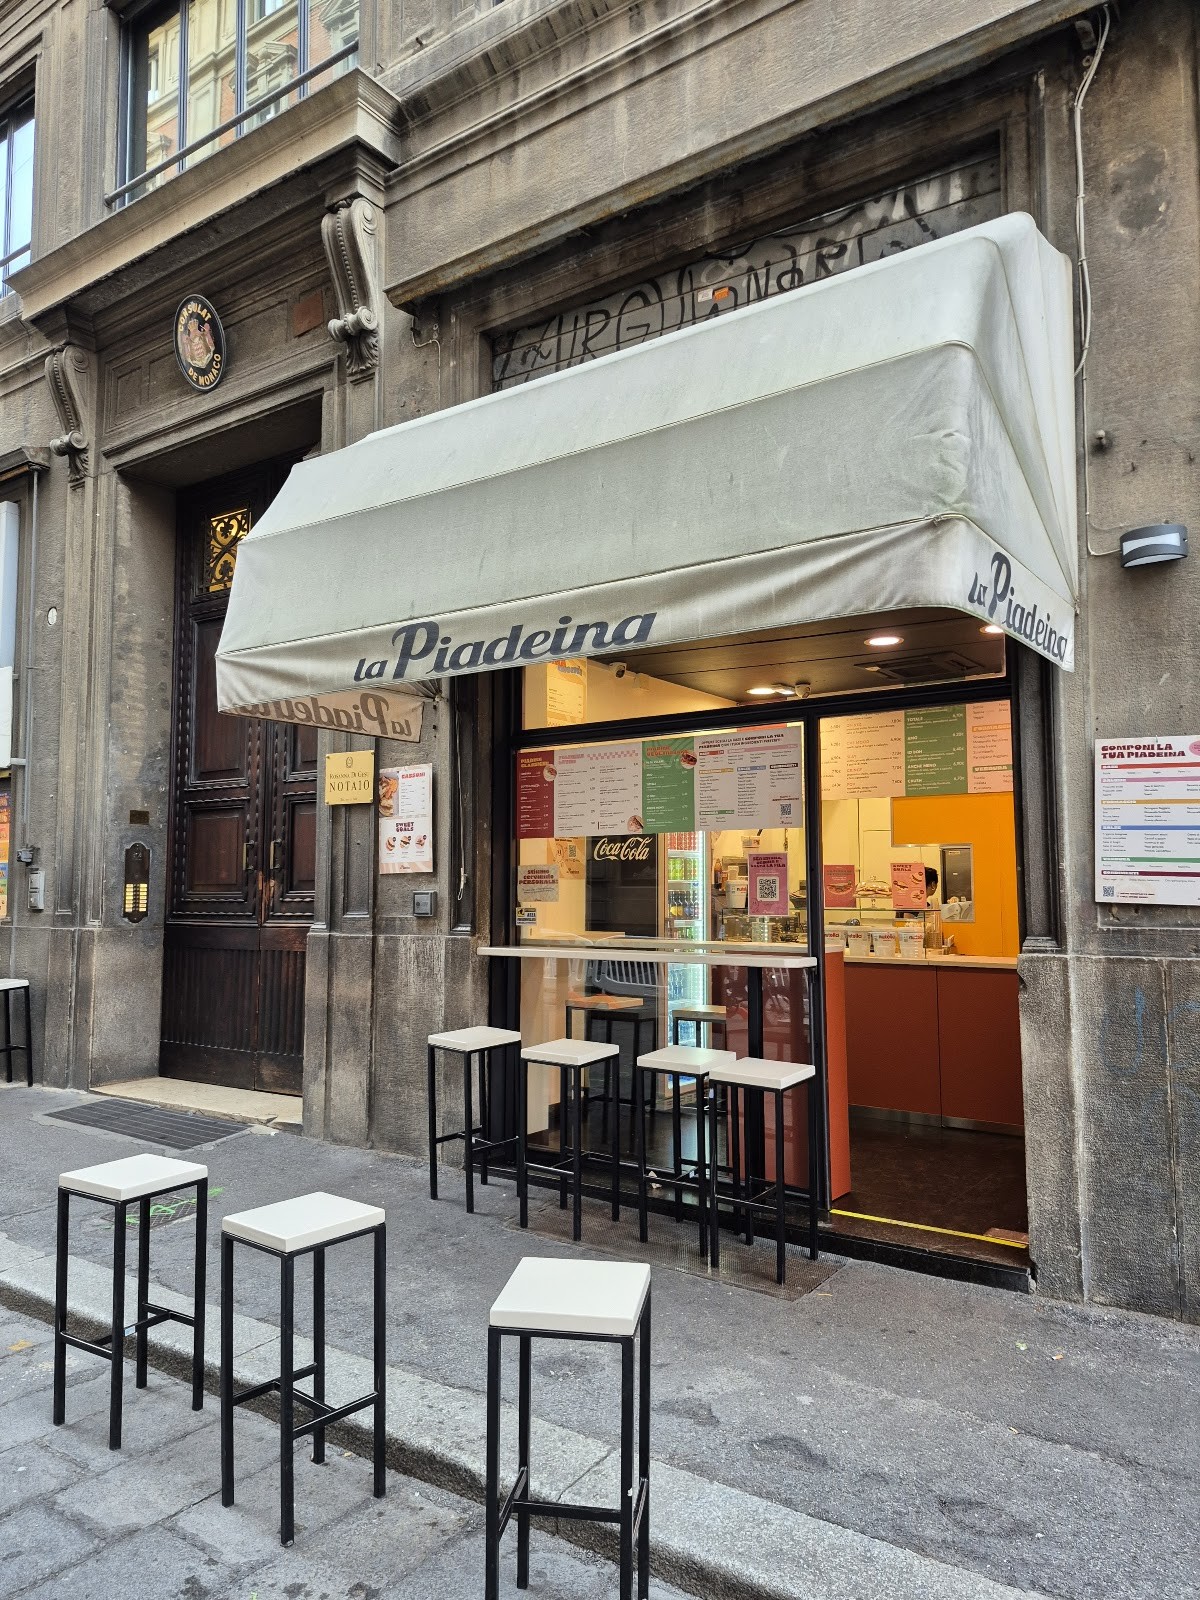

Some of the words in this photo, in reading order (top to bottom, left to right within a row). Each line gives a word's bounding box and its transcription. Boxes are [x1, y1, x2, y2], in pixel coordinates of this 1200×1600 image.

[179, 301, 212, 331] CONSULAT
[188, 367, 198, 381] DE
[199, 354, 221, 386] MONACO
[968, 572, 988, 607] la
[988, 551, 1068, 662] Piadeina
[353, 658, 388, 682] la
[391, 612, 658, 680] Piadeina
[1101, 744, 1155, 752] COMPONI
[1101, 751, 1125, 759] TUA
[1127, 751, 1186, 759] PIADEINA
[329, 779, 370, 792] NOTAIO
[593, 836, 653, 861] Coca-Cola
